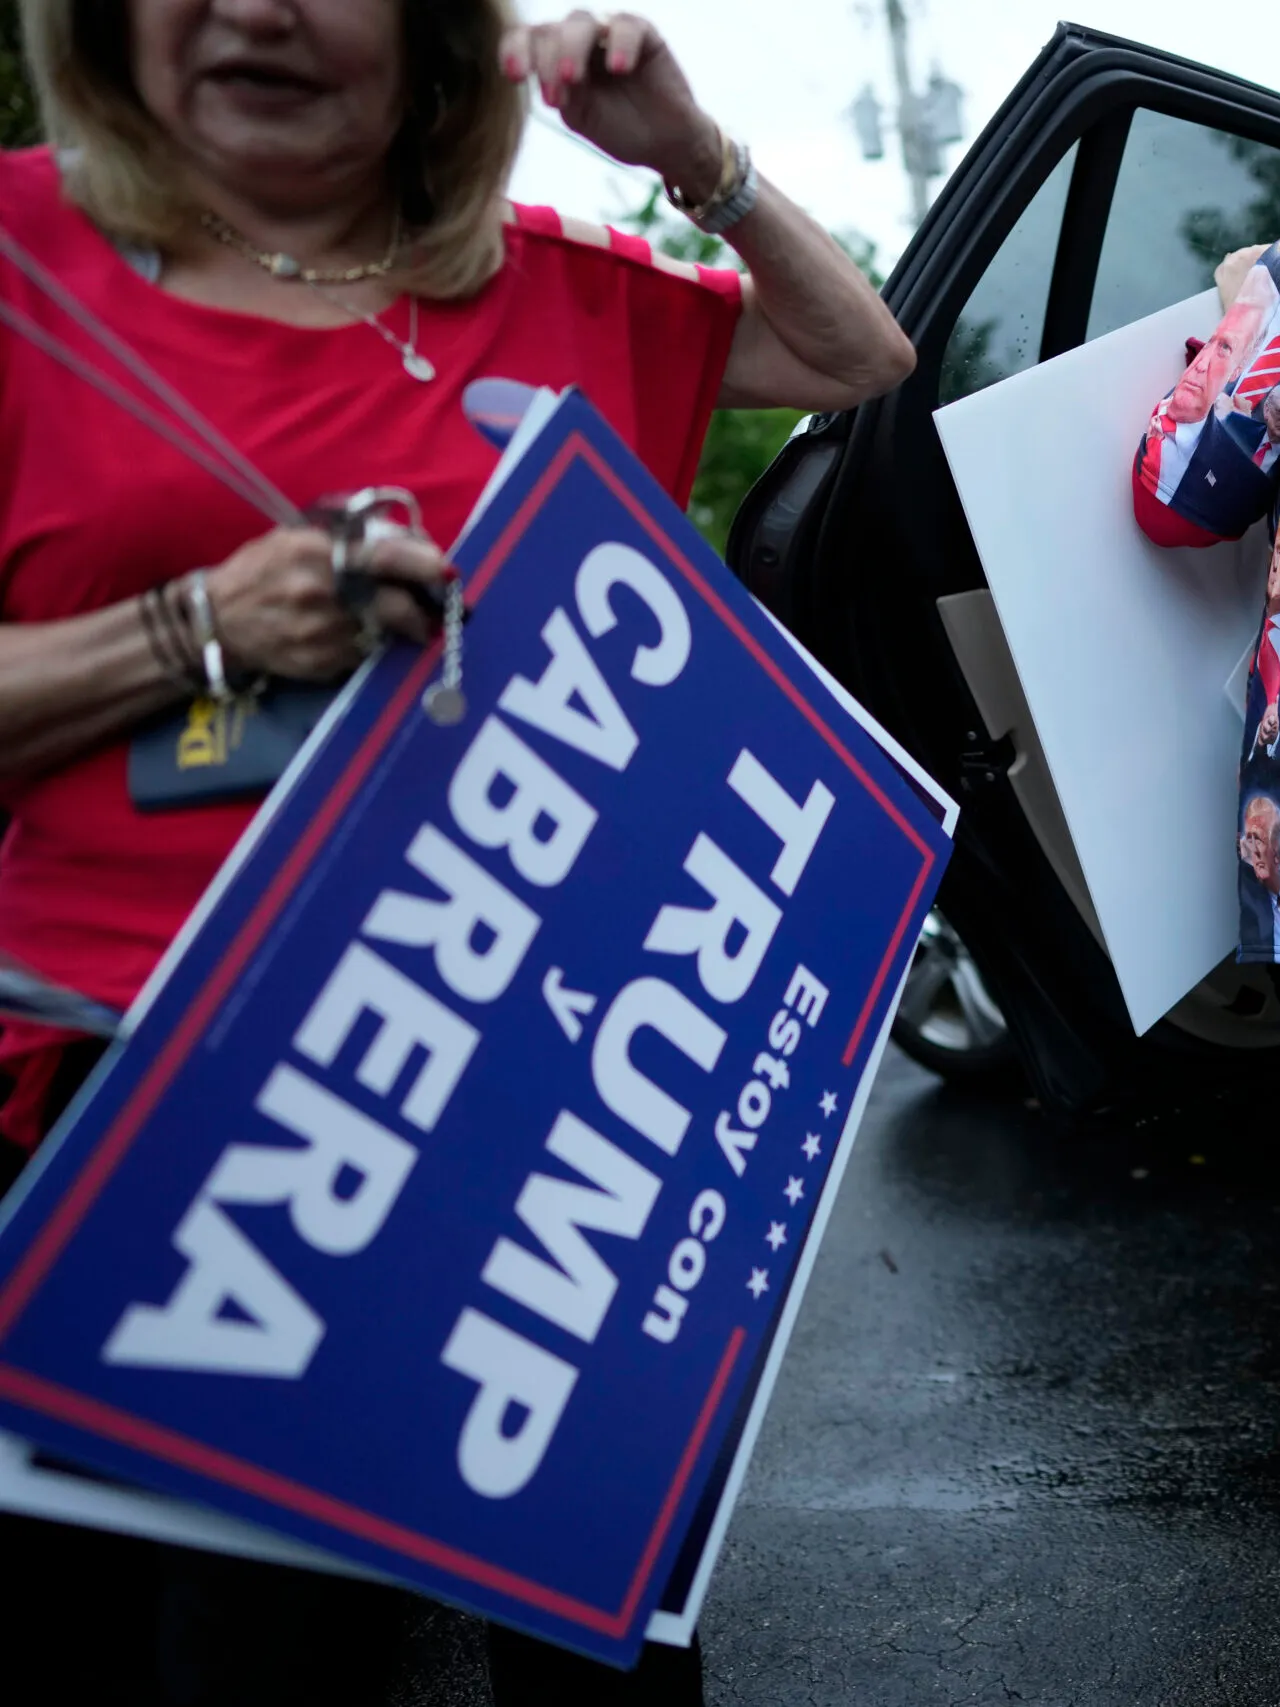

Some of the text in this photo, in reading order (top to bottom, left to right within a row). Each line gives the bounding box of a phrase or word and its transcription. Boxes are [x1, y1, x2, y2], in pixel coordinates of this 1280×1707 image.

[101, 541, 693, 1381] CABRERA
[440, 747, 836, 1499] TRUMP
[541, 965, 598, 1043] y
[641, 963, 830, 1344] Estoy con
